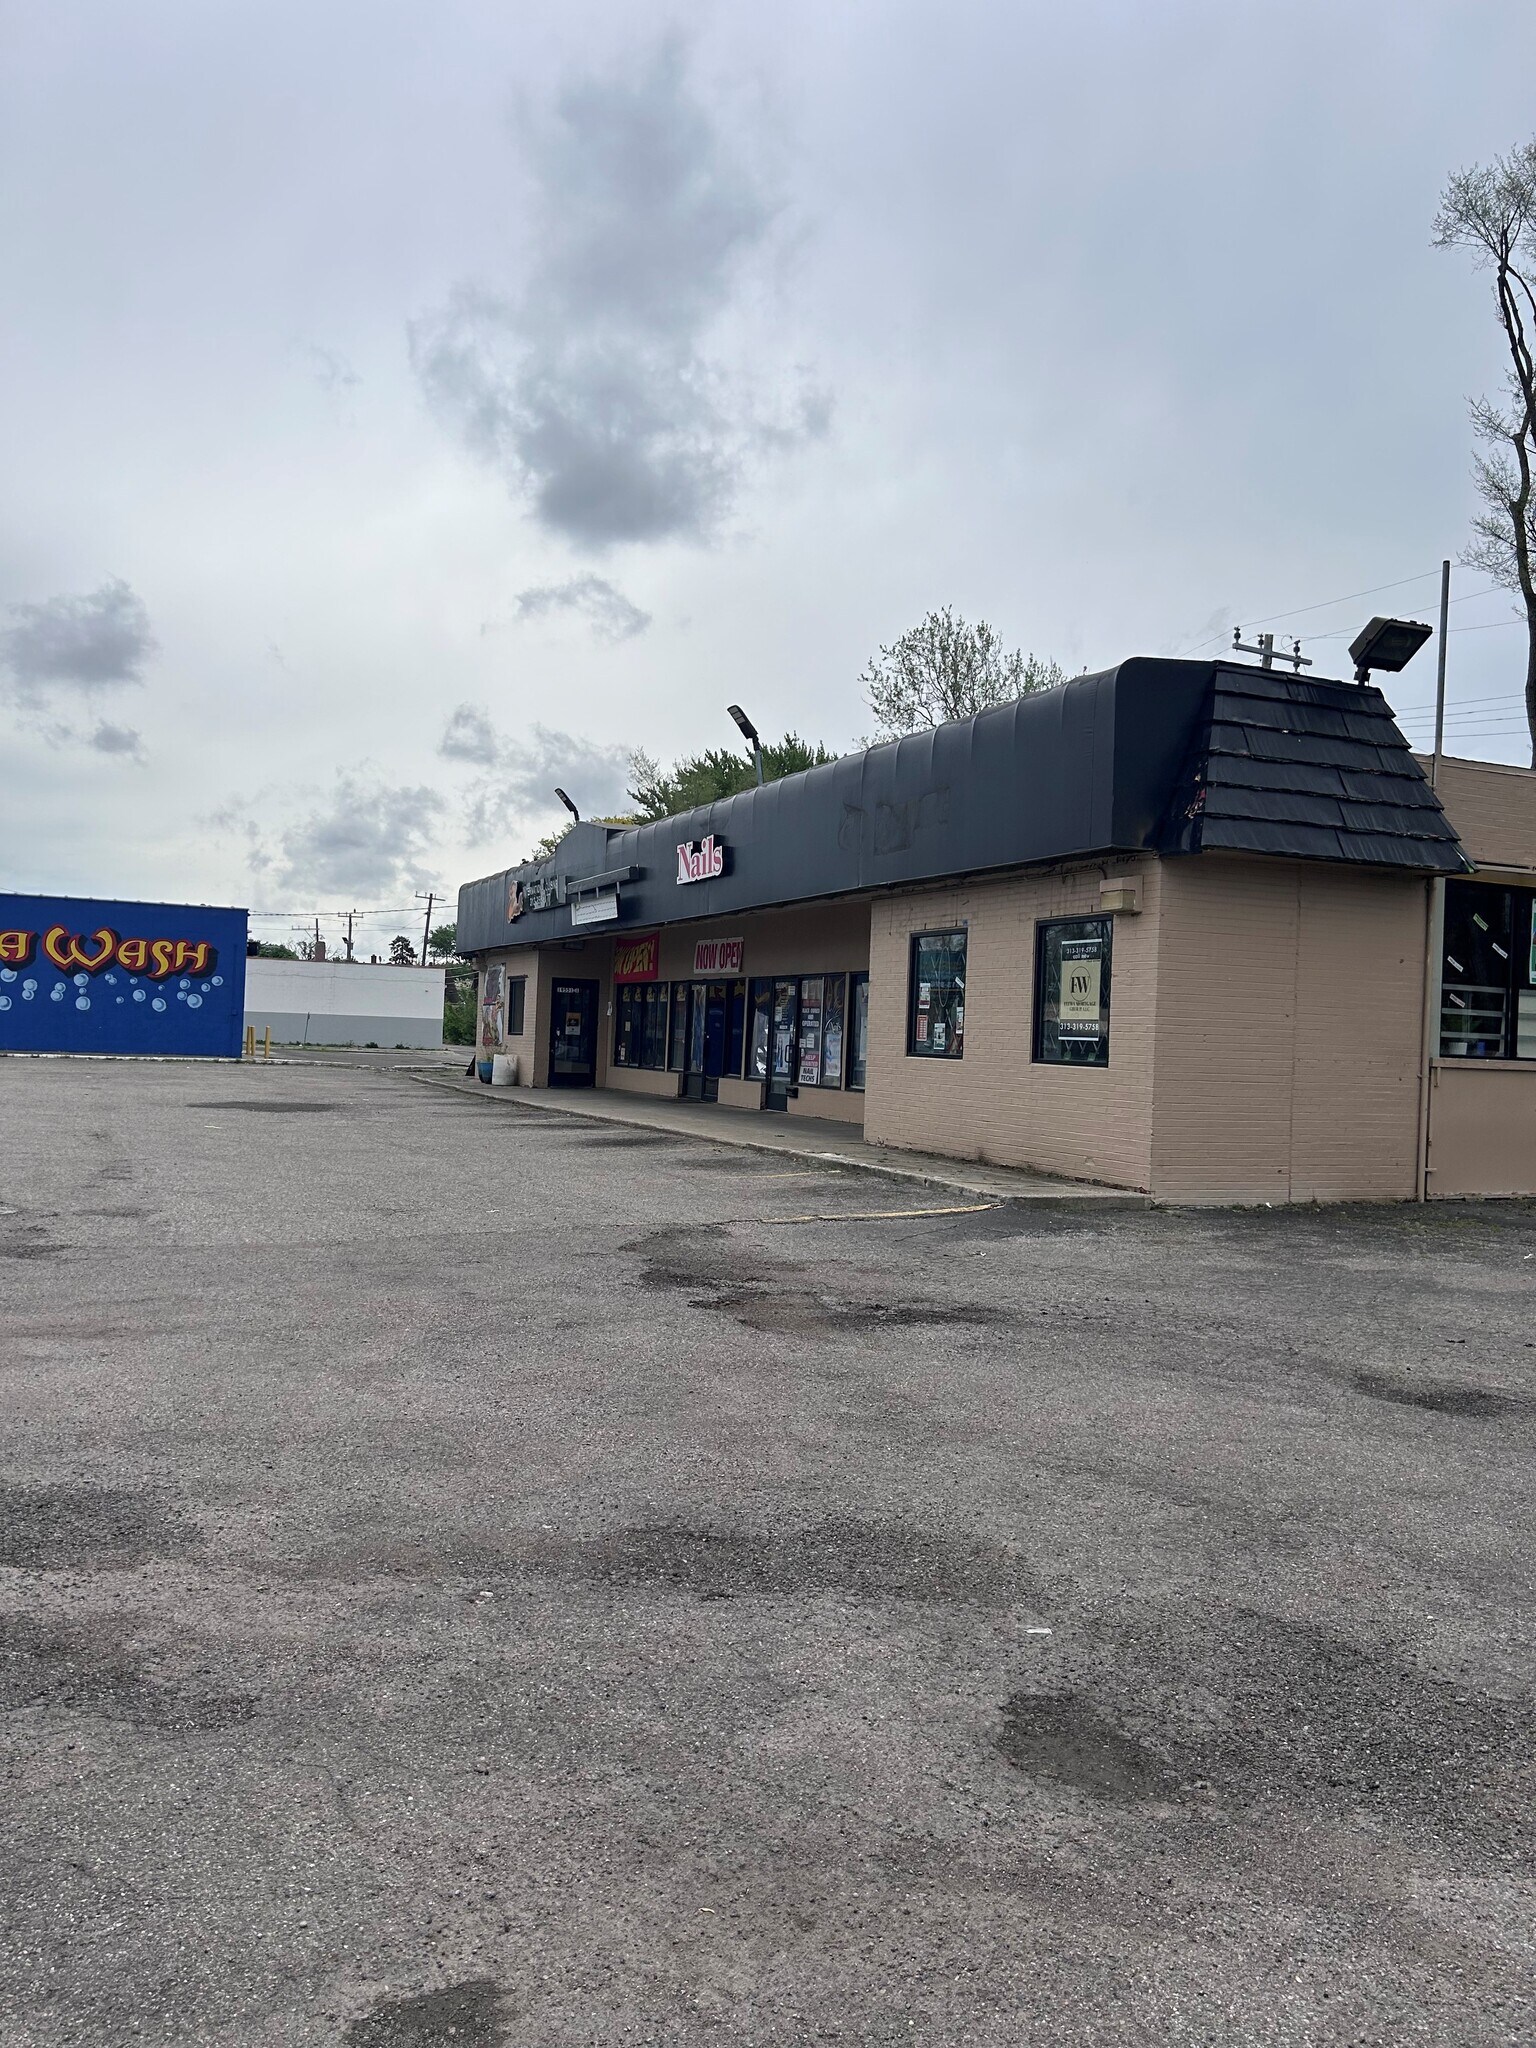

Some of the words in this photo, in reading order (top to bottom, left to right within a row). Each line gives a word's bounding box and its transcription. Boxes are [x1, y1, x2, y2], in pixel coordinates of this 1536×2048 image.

[677, 834, 723, 884] Nails
[696, 943, 718, 970] NOW
[719, 941, 744, 969] OPEN
[1060, 1022, 1098, 1031] 313-319-5758
[800, 1074, 815, 1083] TECHS
